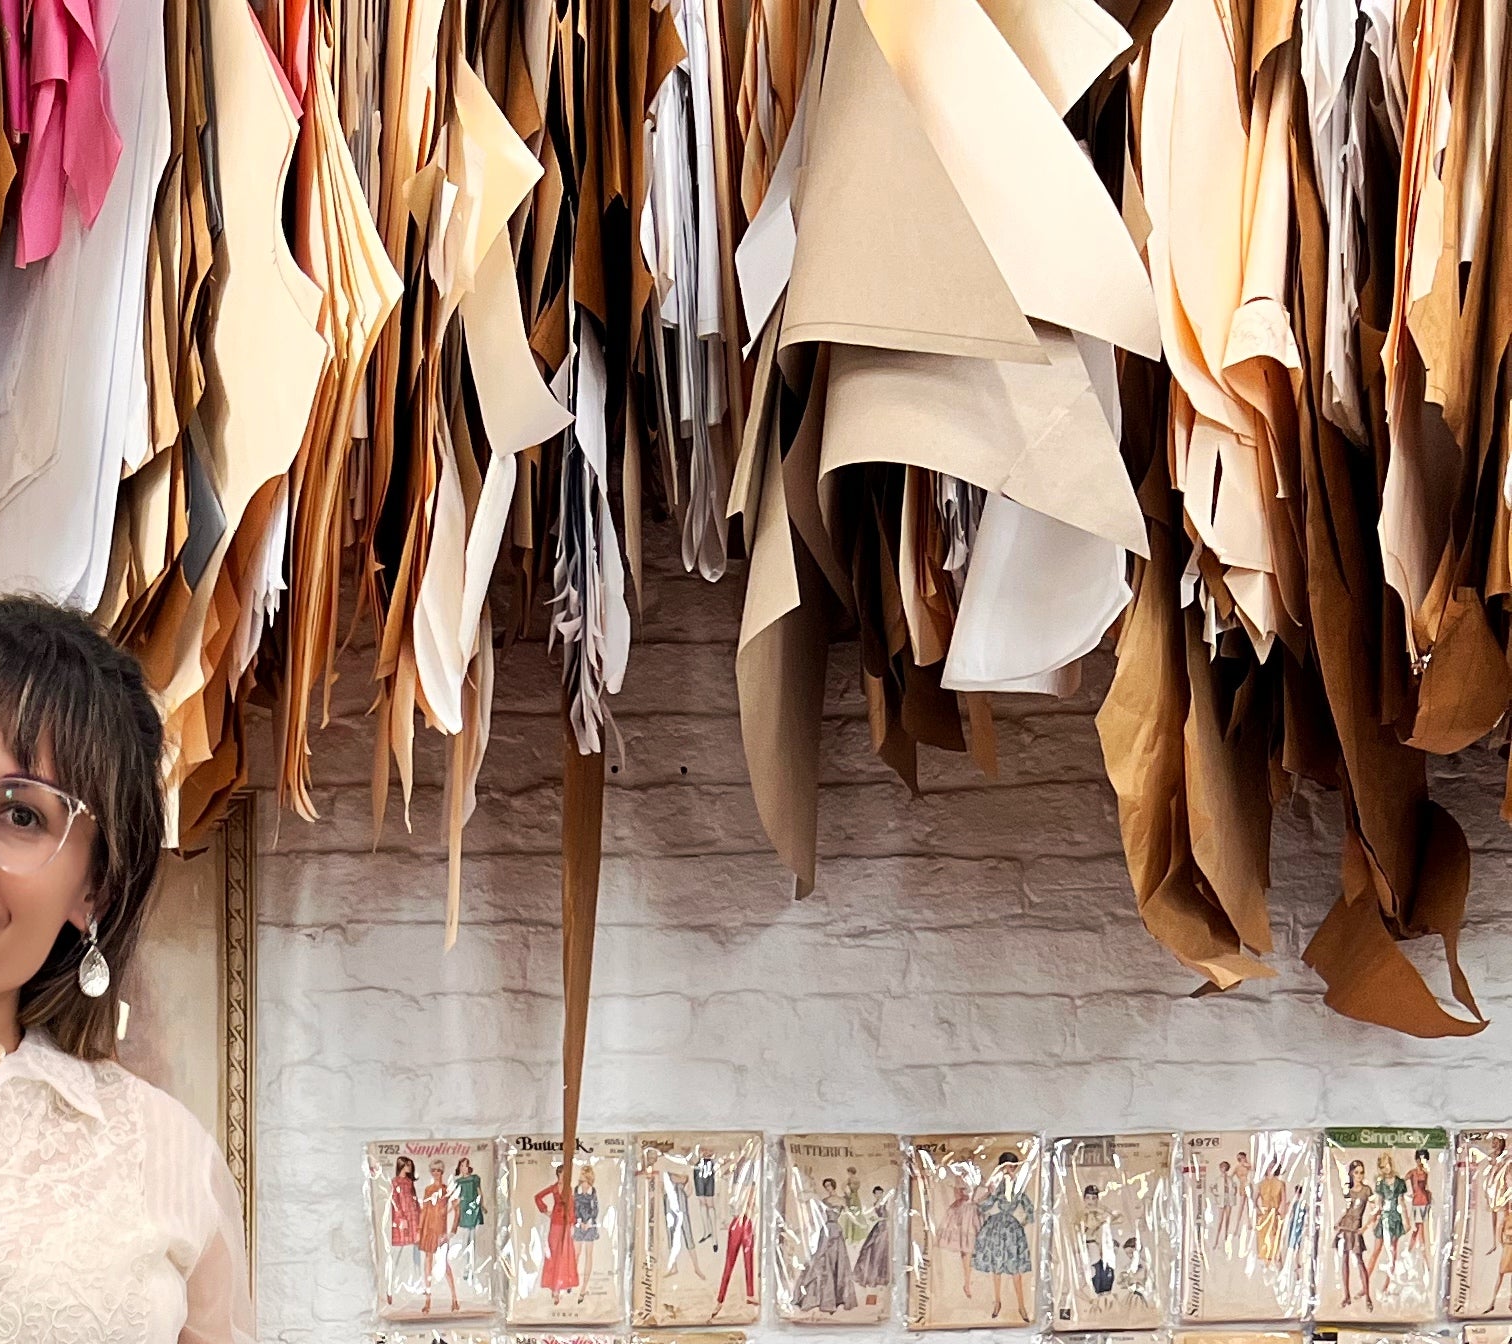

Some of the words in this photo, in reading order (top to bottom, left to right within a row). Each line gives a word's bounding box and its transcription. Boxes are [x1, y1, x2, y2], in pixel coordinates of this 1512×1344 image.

[516, 1136, 594, 1153] Butterk
[1360, 1129, 1430, 1149] Simplicity
[378, 1145, 400, 1154] 7252
[404, 1142, 472, 1157] Simplicity
[790, 1143, 855, 1158] BUTTERICK
[1187, 1250, 1204, 1318] Simplicity
[1454, 1246, 1472, 1315] Simplicity
[915, 1257, 930, 1326] Simplicity
